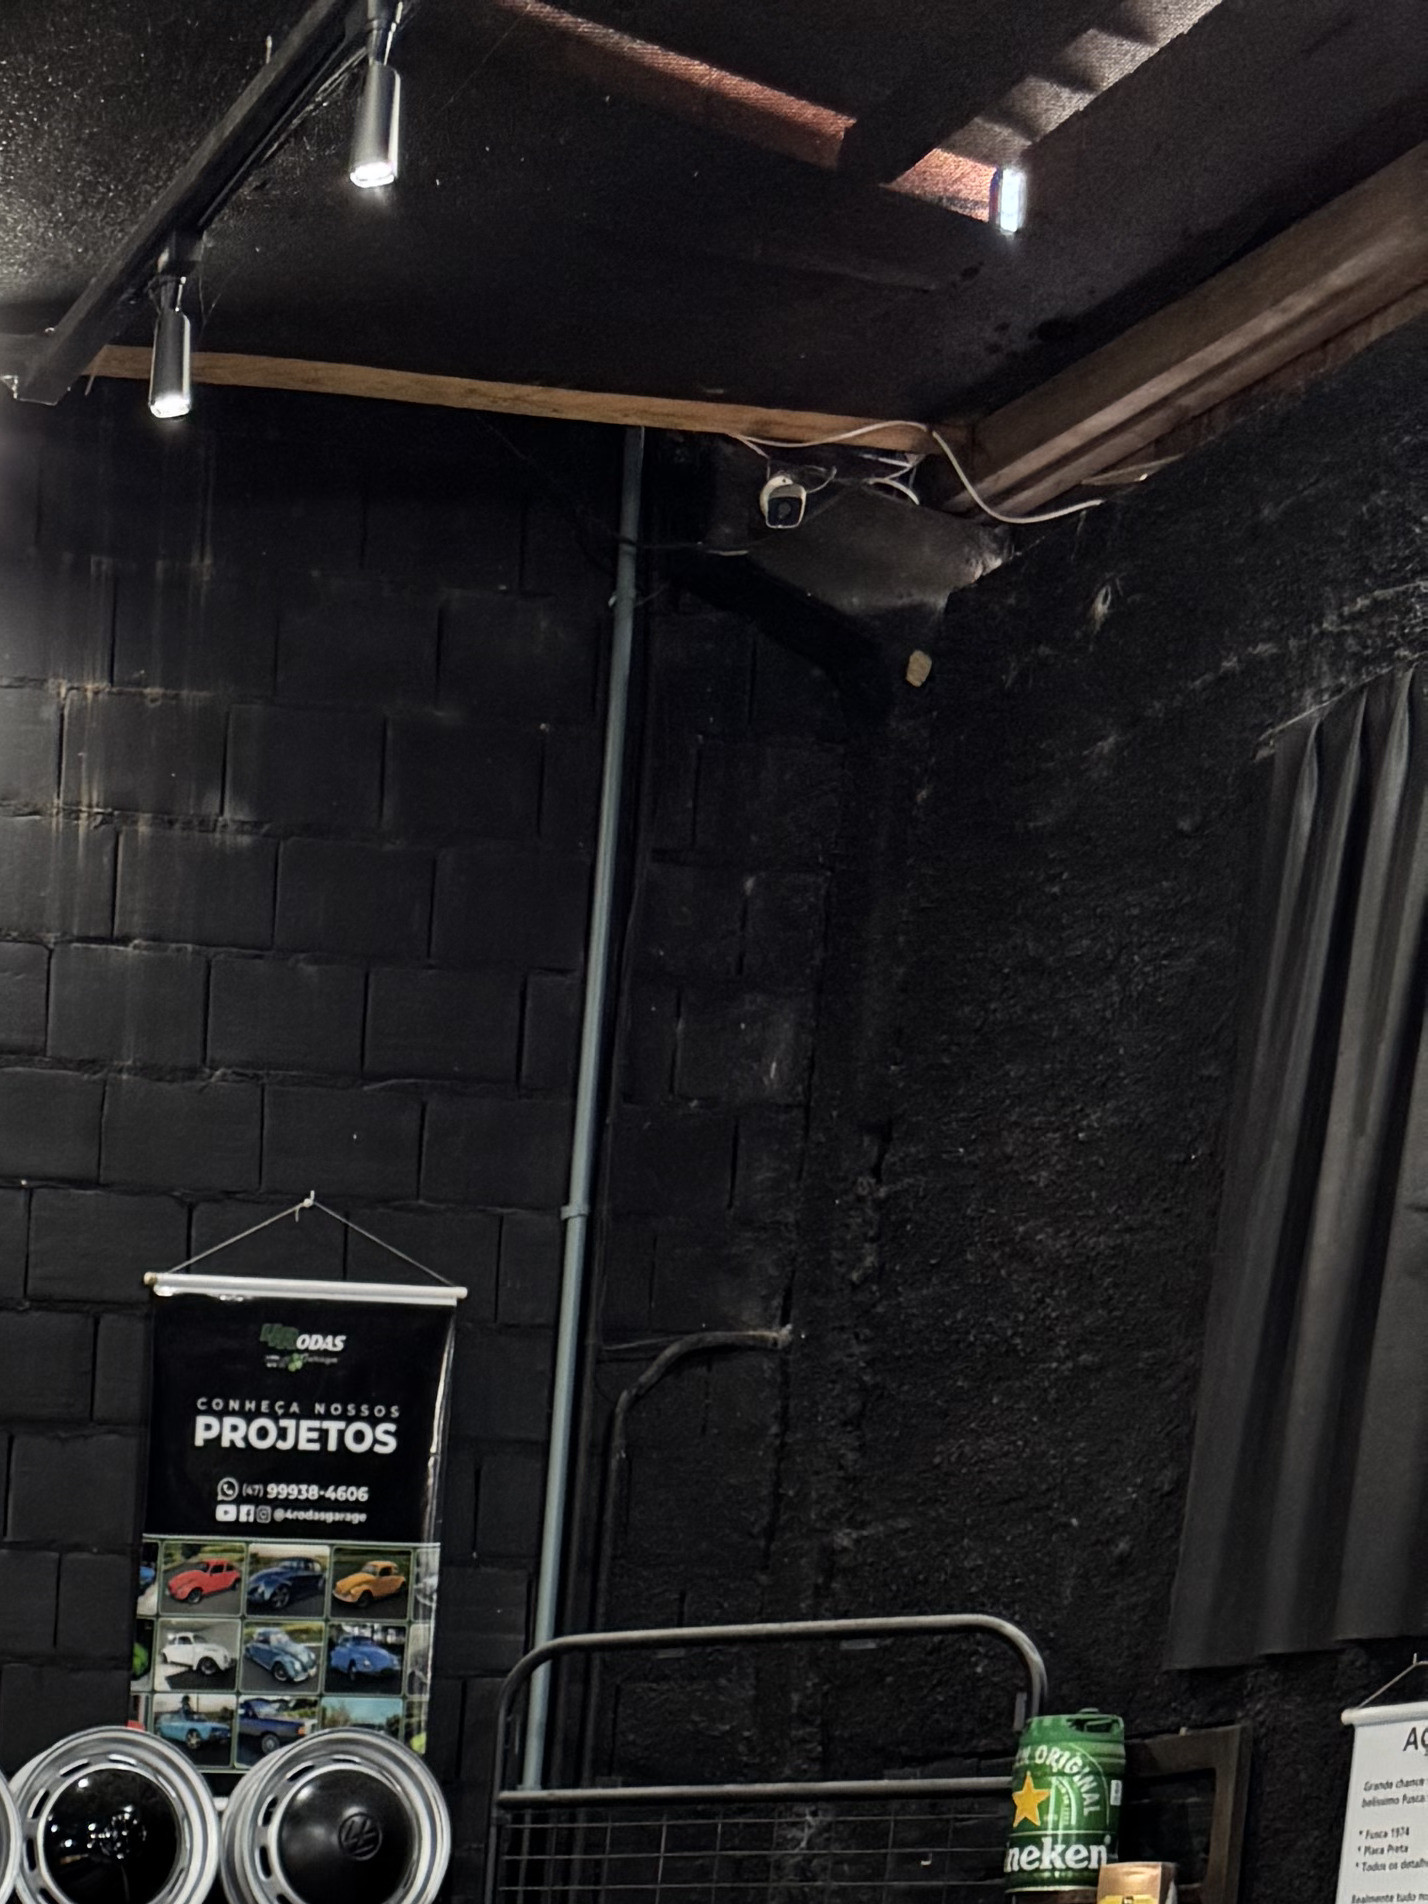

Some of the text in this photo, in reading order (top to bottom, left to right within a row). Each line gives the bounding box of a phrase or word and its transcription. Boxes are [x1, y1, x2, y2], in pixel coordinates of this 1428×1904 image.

[196, 1397, 400, 1418] CONHEÇA NOSSOS
[194, 1415, 398, 1454] PROJETOS
[266, 1483, 369, 1502] 99938-4606
[1034, 1745, 1101, 1817] ORIGINAL
